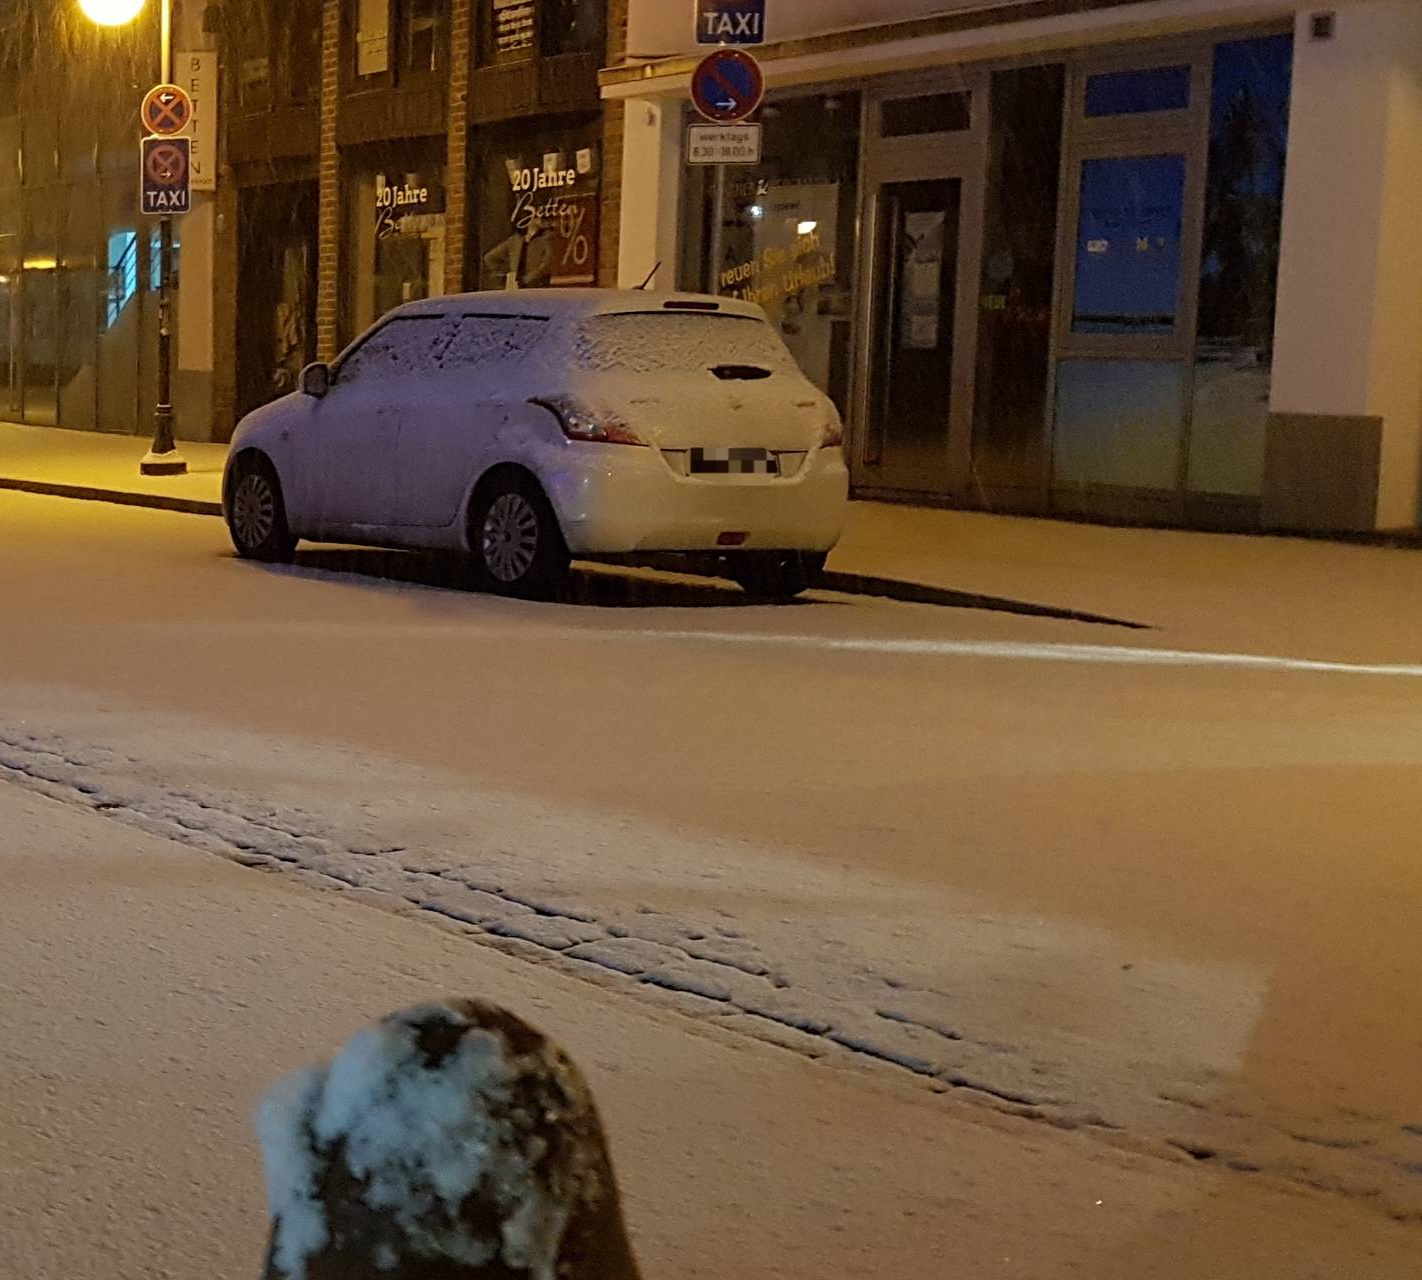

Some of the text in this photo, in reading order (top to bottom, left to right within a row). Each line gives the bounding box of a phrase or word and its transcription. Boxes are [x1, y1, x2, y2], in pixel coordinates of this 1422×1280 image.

[703, 12, 760, 35] TAXI
[190, 57, 201, 175] BETTEN
[699, 132, 749, 143] werktags
[512, 165, 576, 191] 20 Jahre
[146, 190, 185, 207] TAXI
[376, 184, 427, 208] 20 Jahre
[510, 191, 578, 229] Betten
[720, 261, 760, 288] reuen
